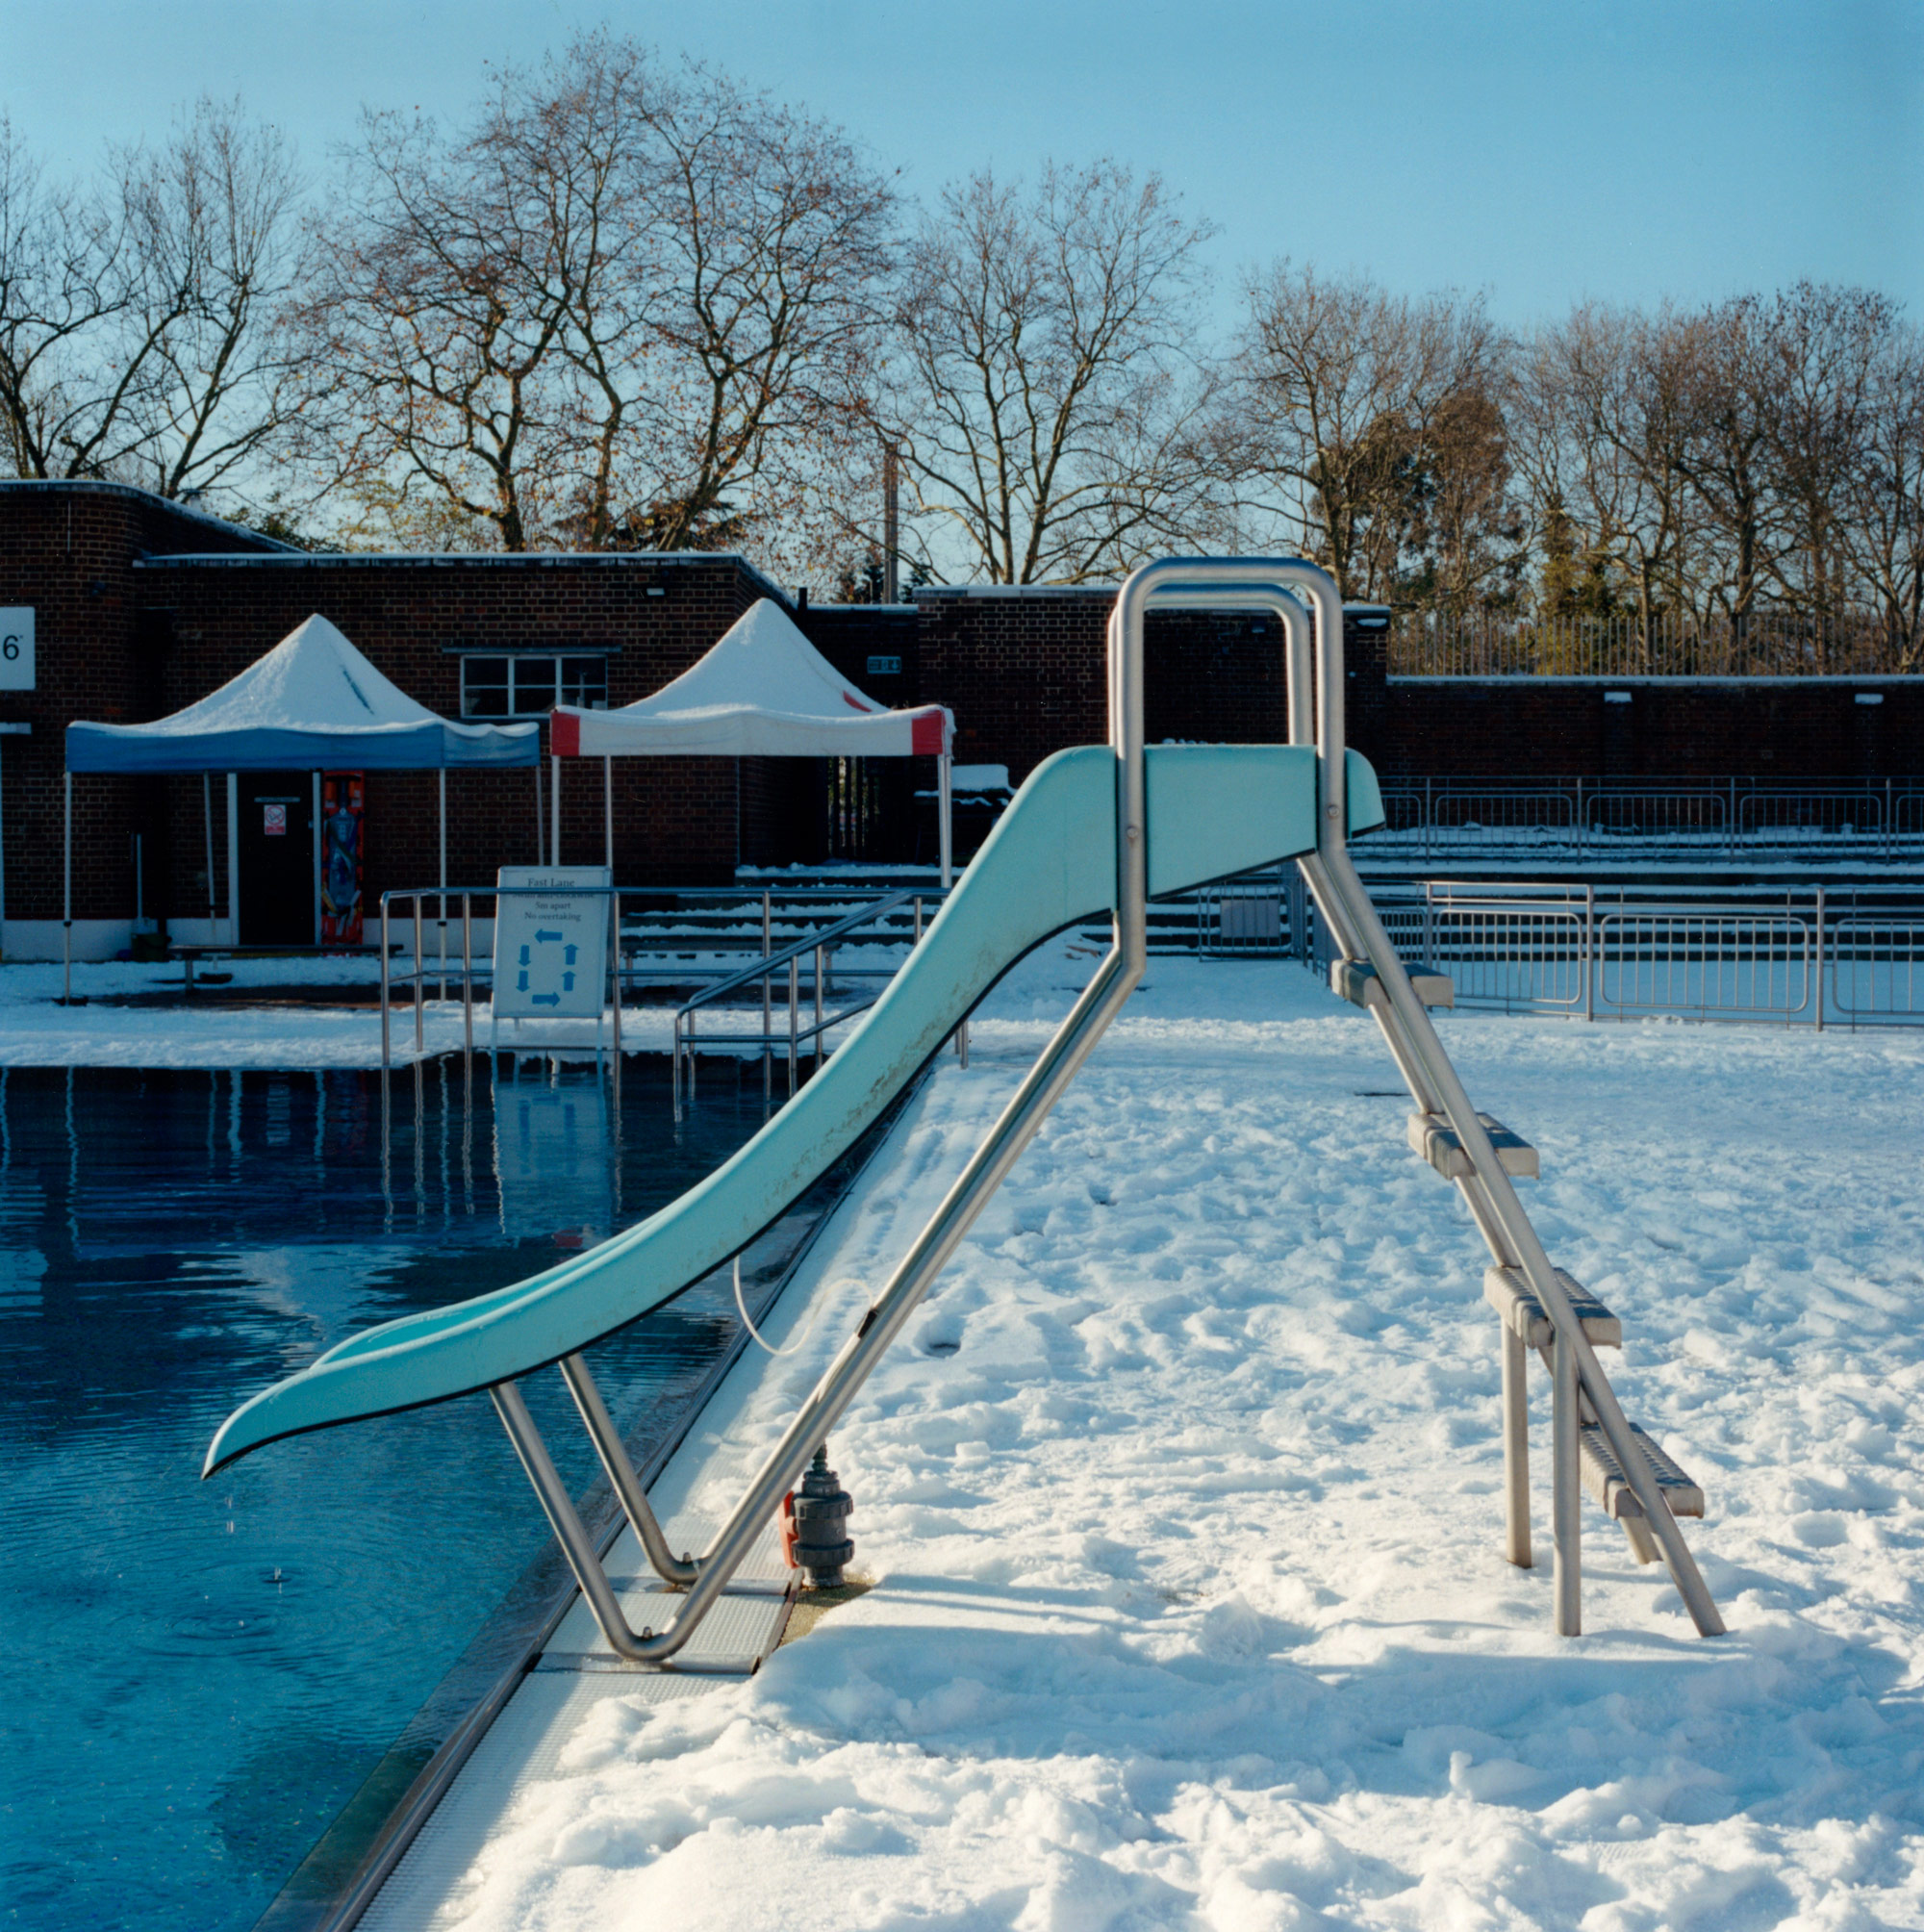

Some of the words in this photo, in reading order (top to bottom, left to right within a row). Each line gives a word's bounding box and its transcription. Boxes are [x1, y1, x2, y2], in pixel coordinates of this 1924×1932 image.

[527, 877, 547, 887] Fast
[550, 877, 575, 887] Lane
[550, 902, 570, 911] apart
[524, 911, 537, 920] No
[538, 911, 581, 922] overtaking
